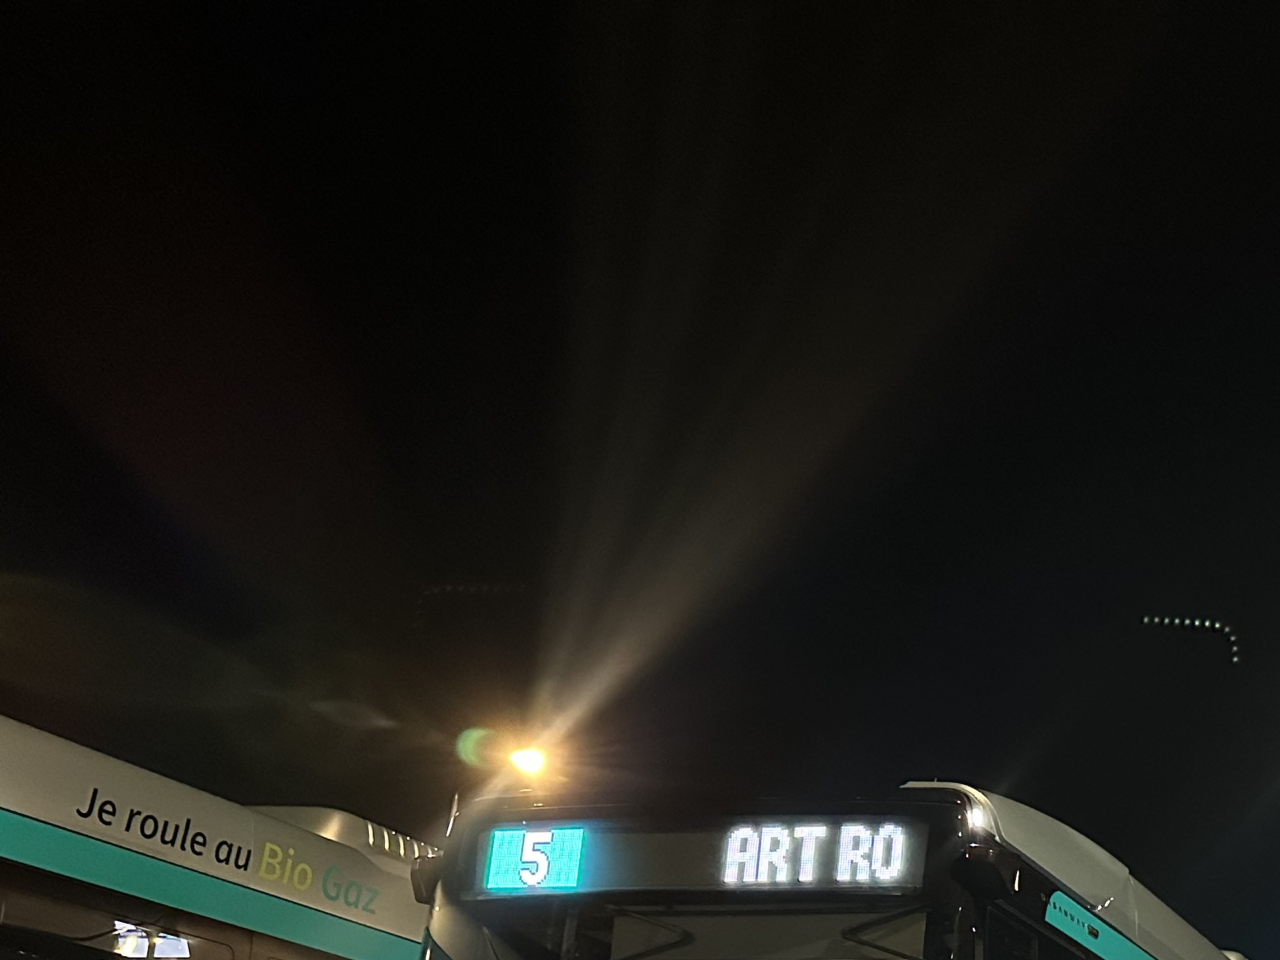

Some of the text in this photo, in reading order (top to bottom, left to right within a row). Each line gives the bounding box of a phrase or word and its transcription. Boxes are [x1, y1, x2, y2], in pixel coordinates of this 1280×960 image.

[75, 788, 381, 916] Je roule au Bio Gaz
[518, 831, 554, 886] 5
[722, 824, 827, 884] ART
